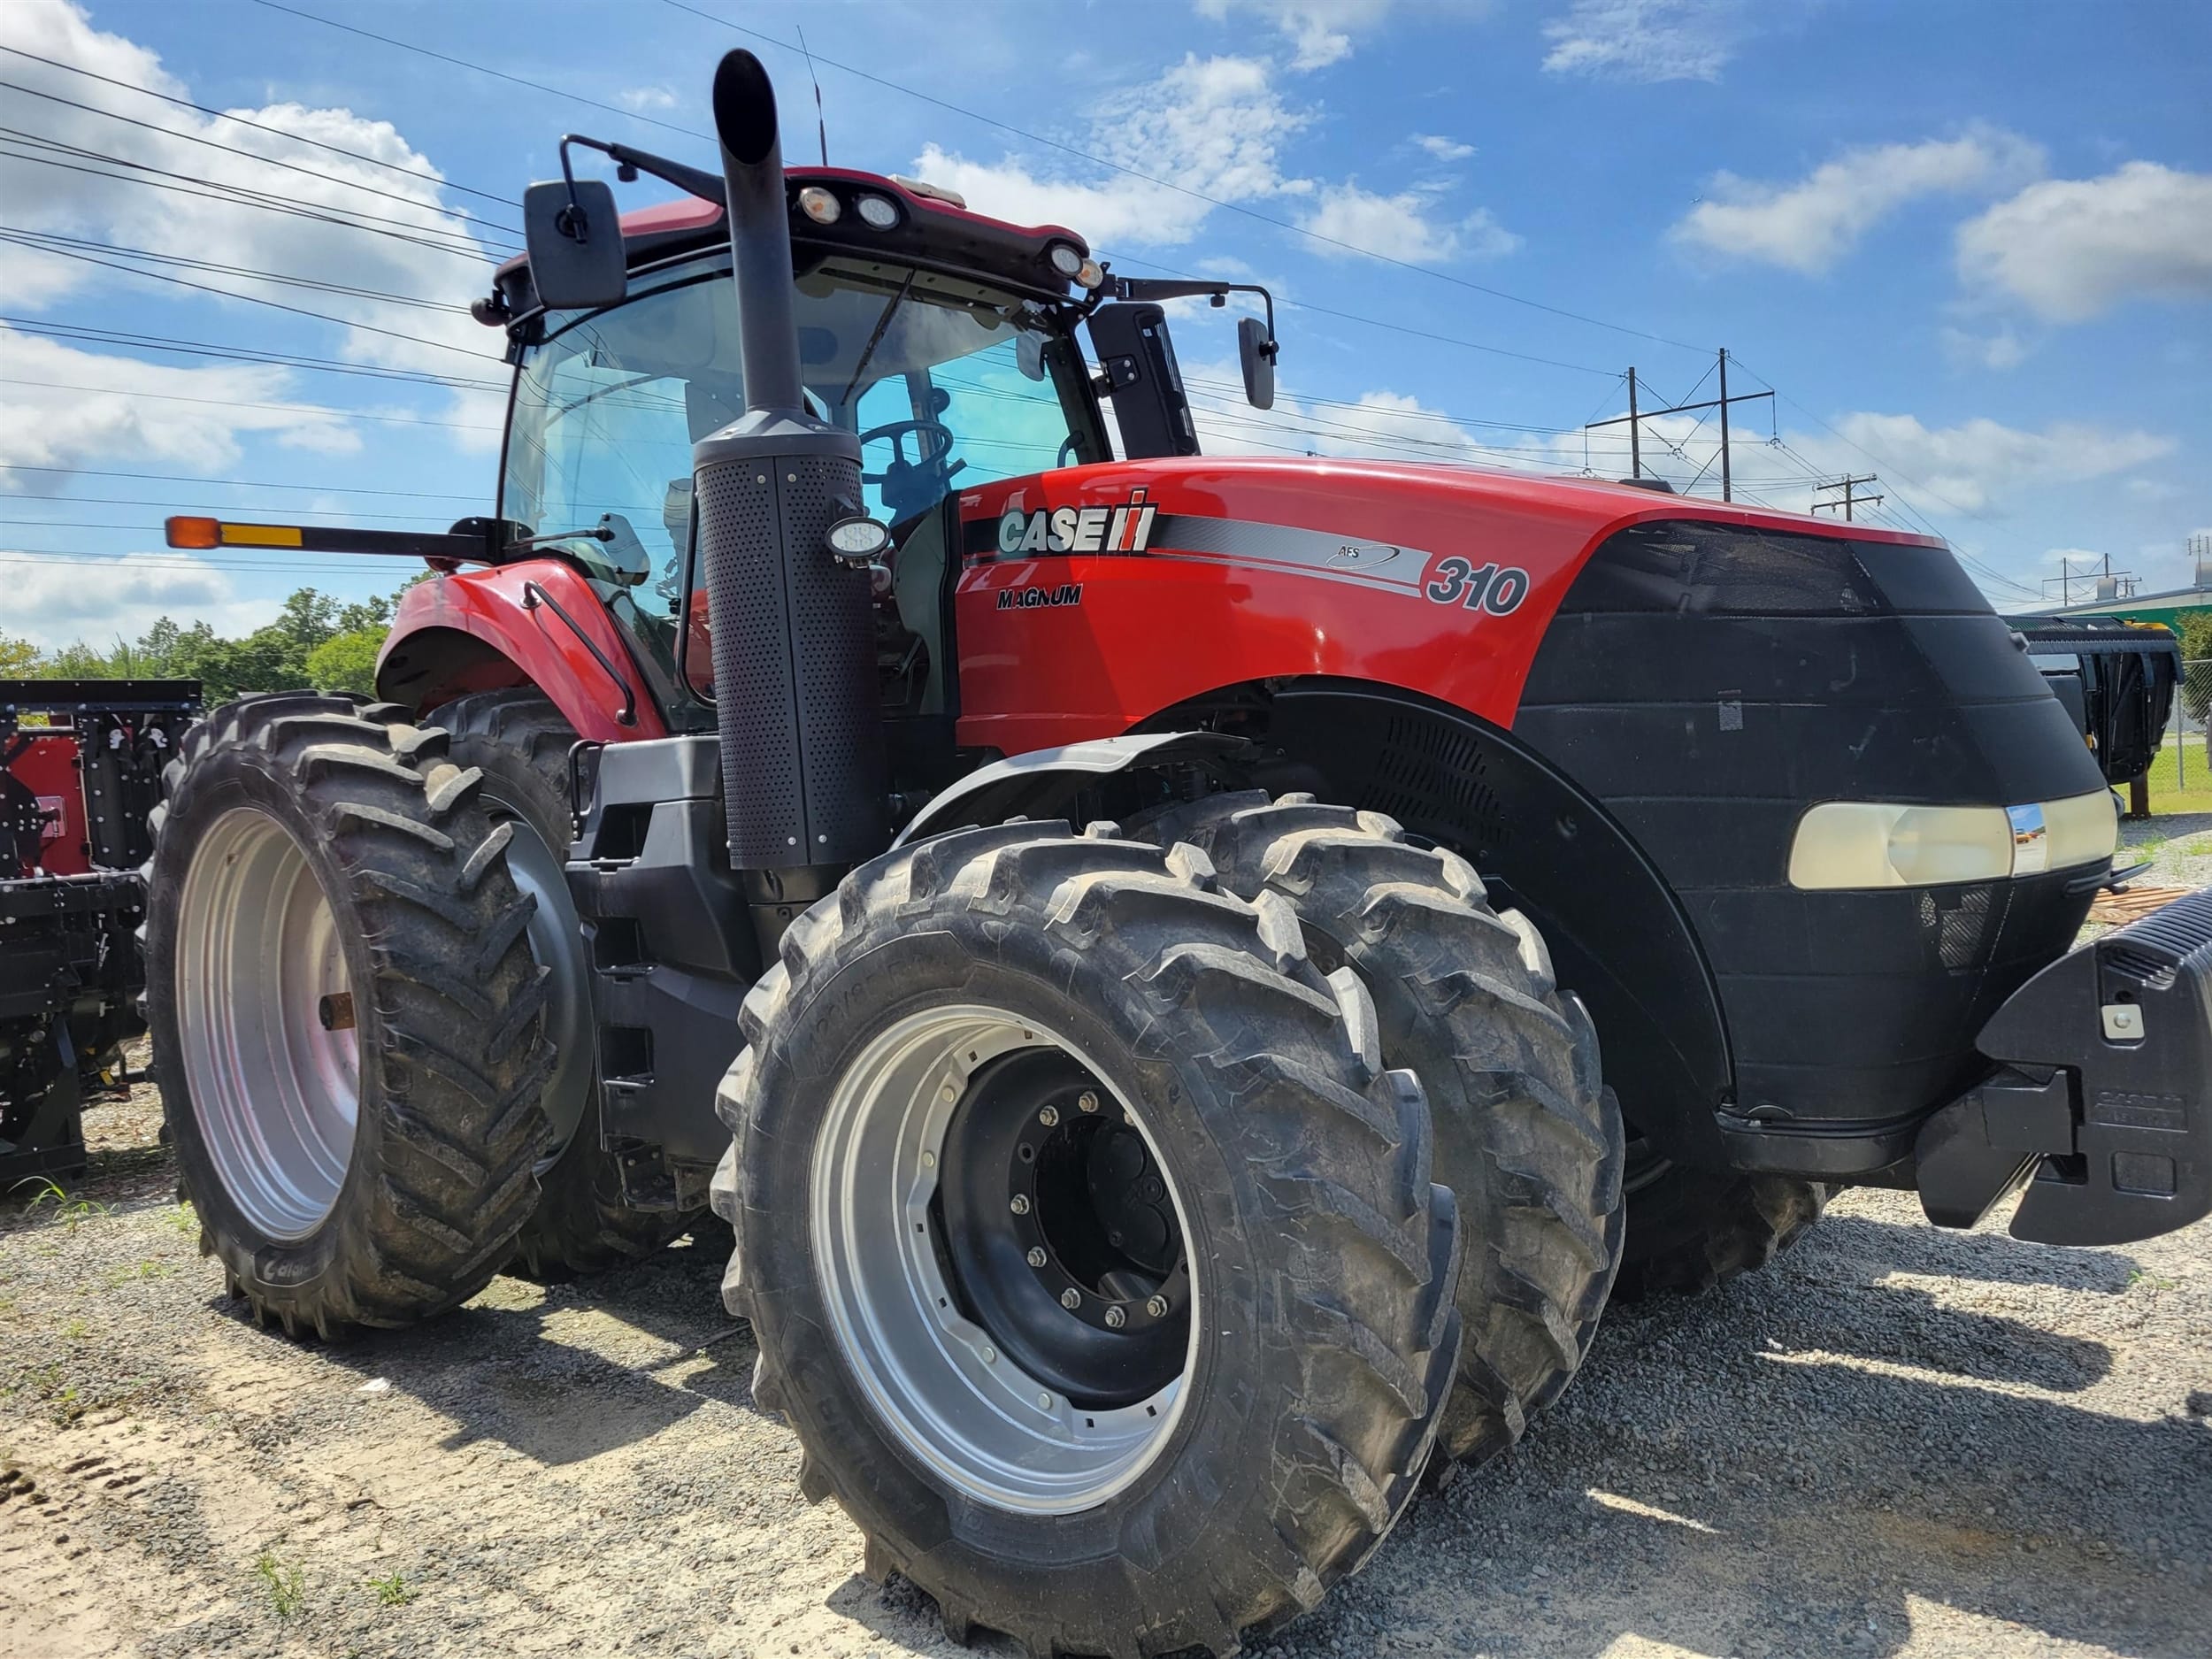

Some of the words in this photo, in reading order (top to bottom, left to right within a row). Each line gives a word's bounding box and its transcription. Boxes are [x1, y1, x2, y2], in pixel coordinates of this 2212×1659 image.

[998, 507, 1108, 552] CASE
[1338, 546, 1360, 558] AFS
[996, 583, 1083, 611] MAGNUM
[1425, 556, 1530, 617] 310
